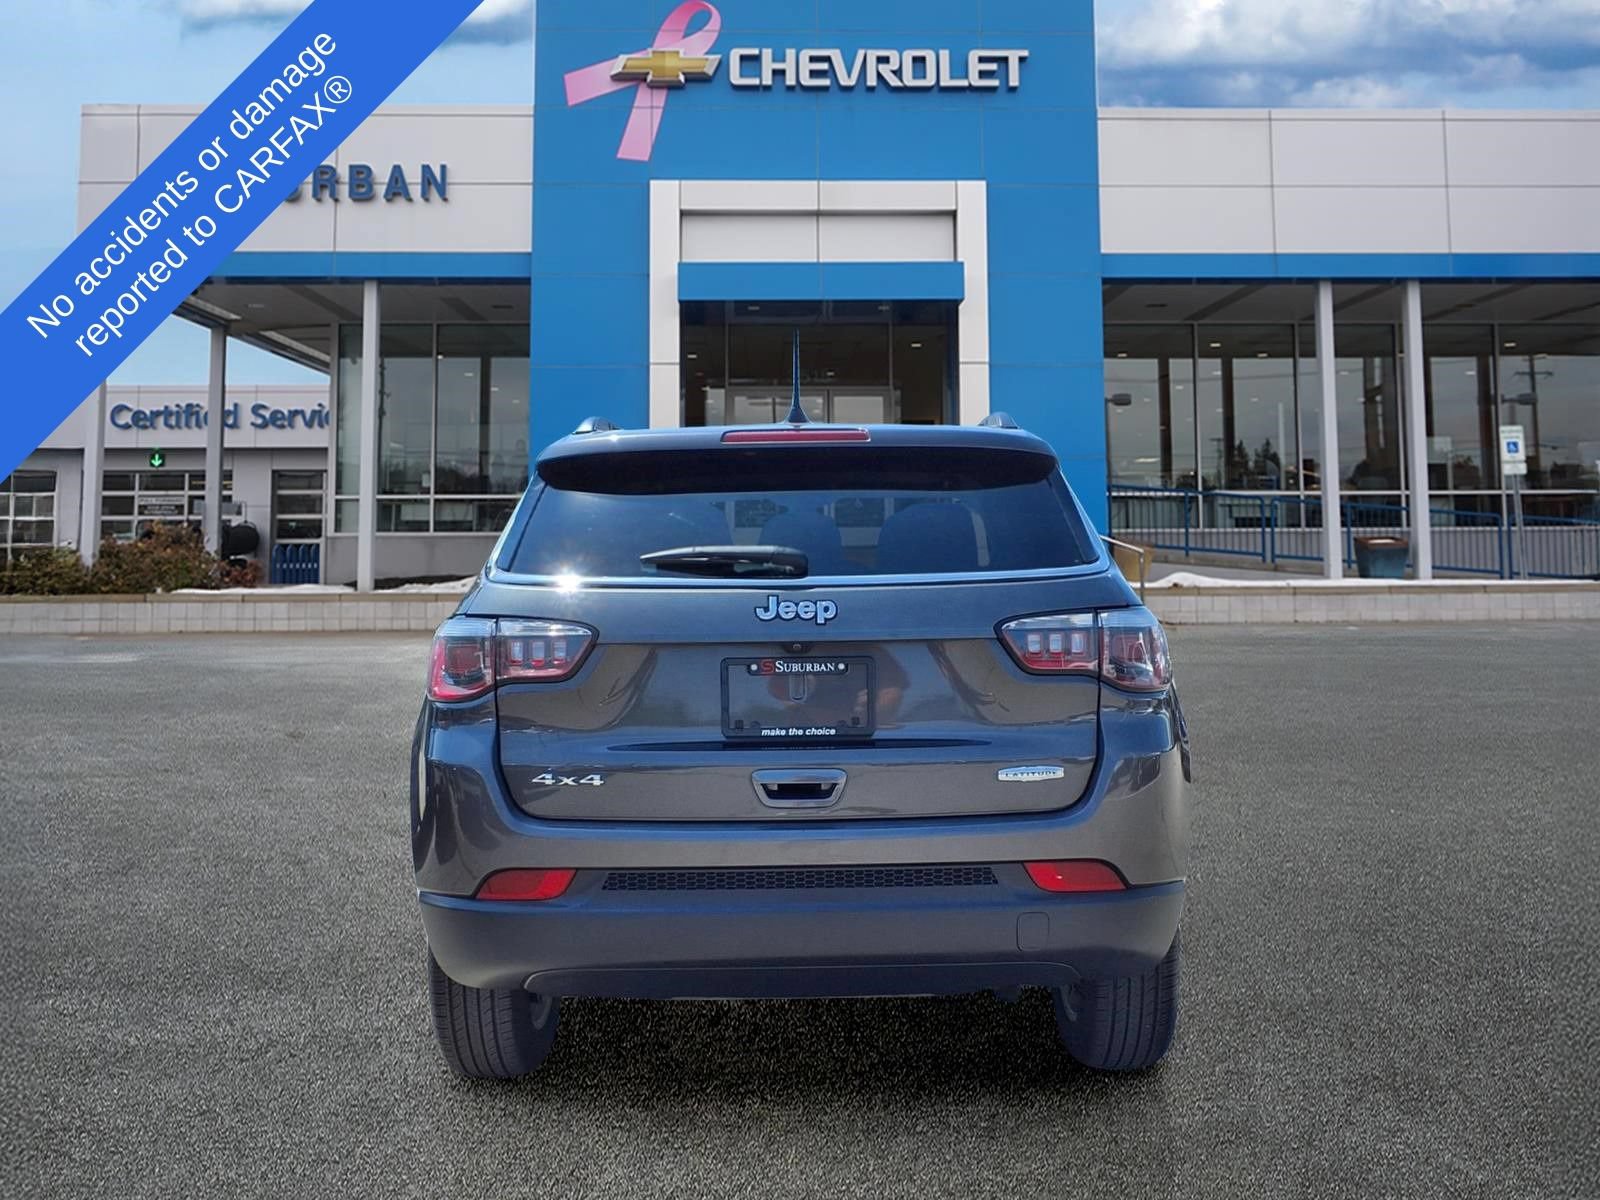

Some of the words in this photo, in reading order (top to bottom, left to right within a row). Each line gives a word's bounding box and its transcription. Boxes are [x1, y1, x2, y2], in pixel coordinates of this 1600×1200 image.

[728, 48, 1029, 89] CHEVROLET
[285, 164, 448, 202] RBAN
[755, 594, 838, 625] Jeep
[775, 660, 835, 673] SUBURBAN
[761, 727, 786, 737] make
[788, 727, 804, 737] the
[806, 727, 836, 737] choice
[532, 772, 604, 786] 4x4
